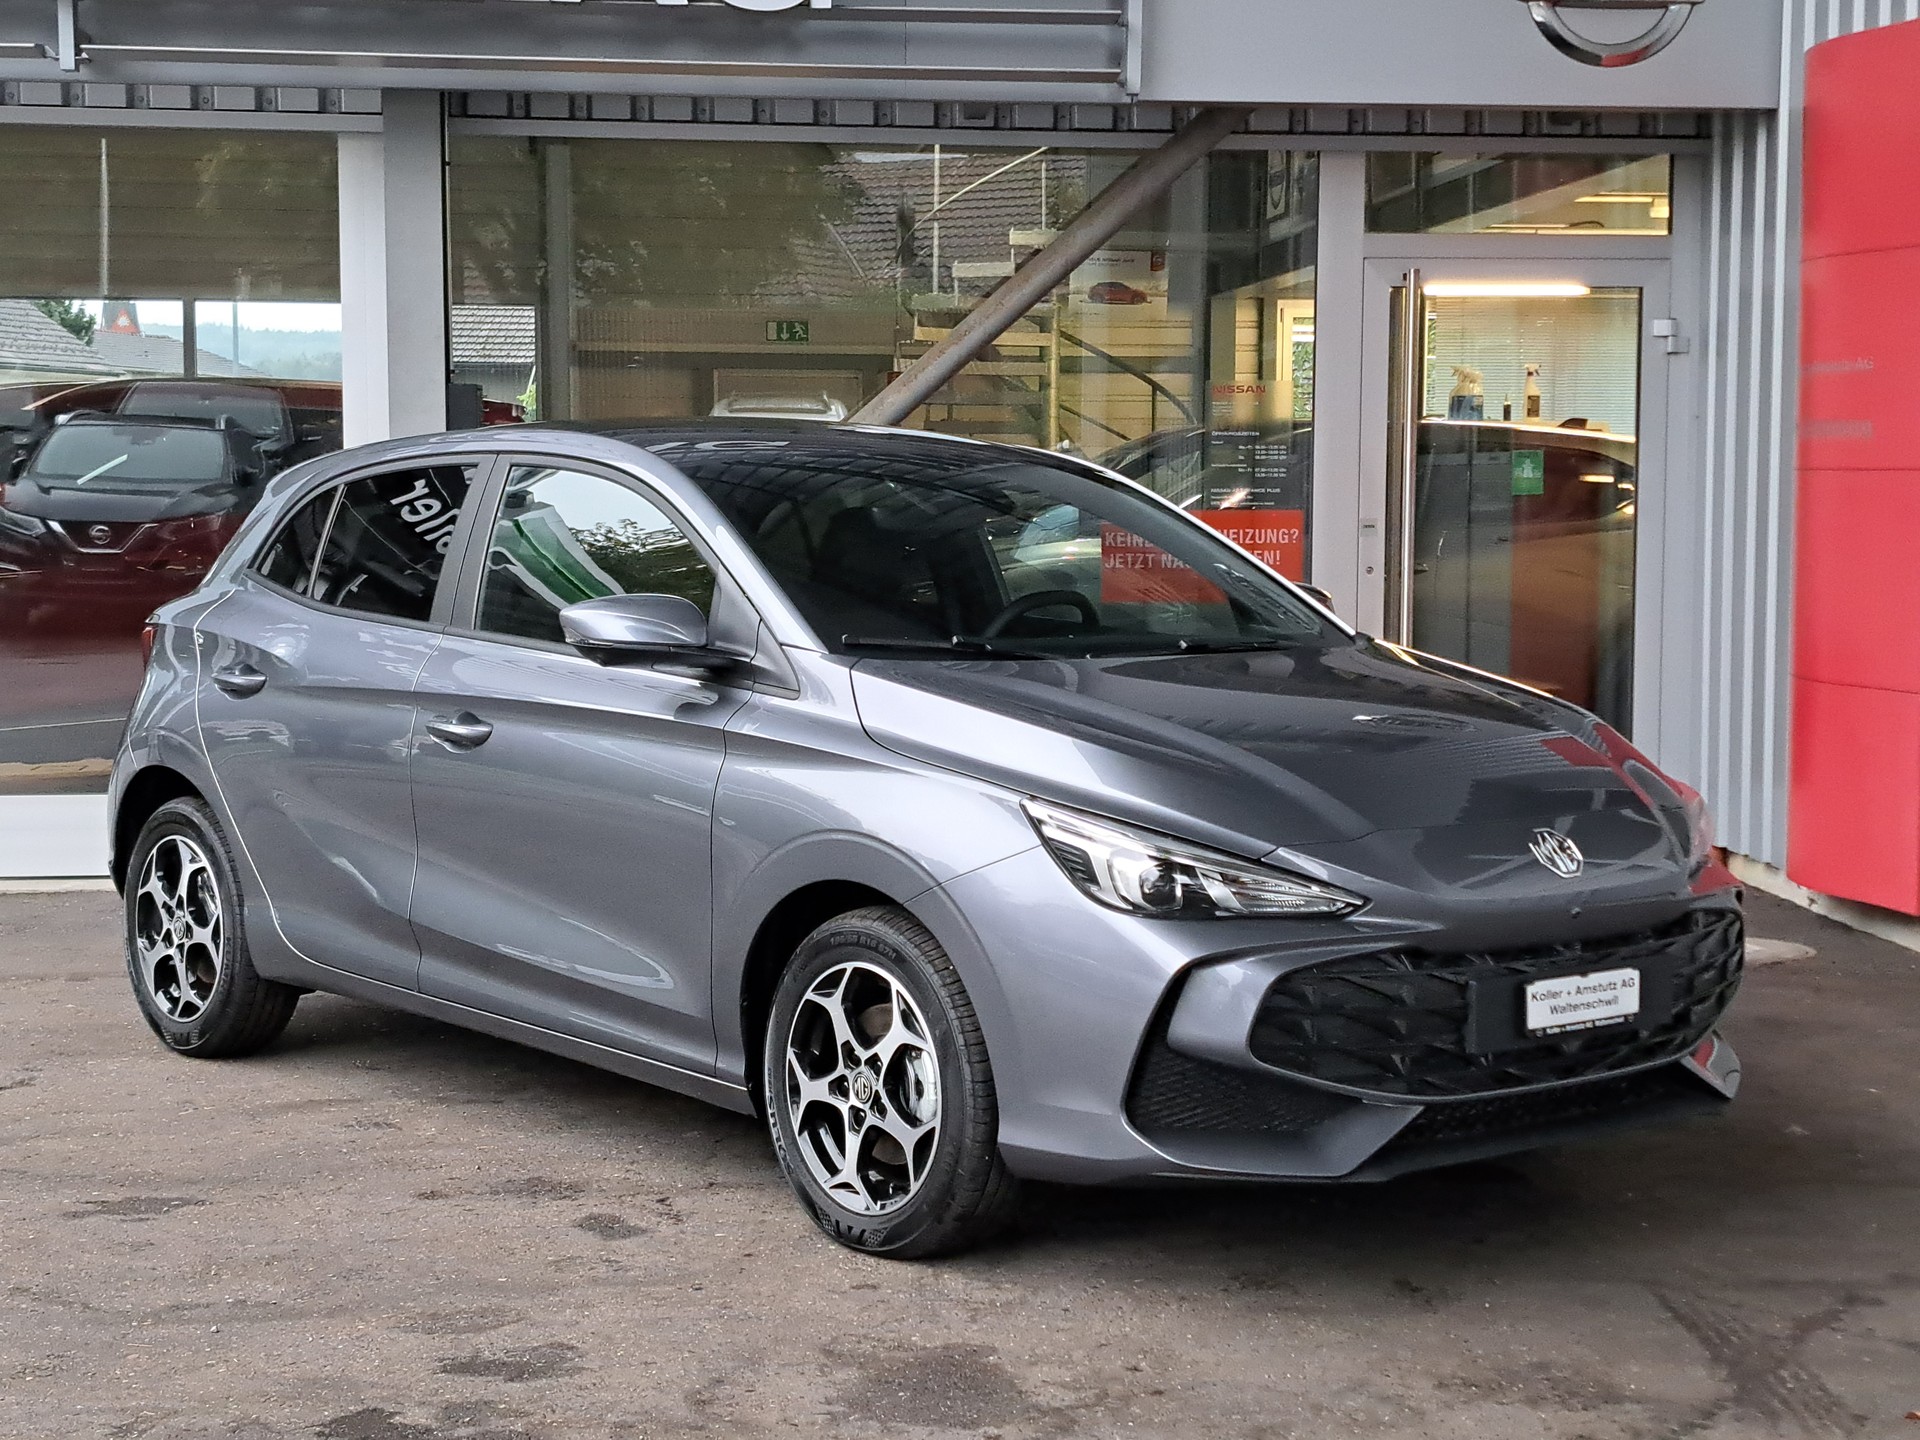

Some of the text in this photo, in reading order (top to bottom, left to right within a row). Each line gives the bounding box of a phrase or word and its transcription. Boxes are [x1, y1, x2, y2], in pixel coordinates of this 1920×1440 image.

[1212, 384, 1266, 394] NISSAN
[1104, 553, 1156, 569] JETZT
[1531, 990, 1563, 1002] Koller
[1575, 982, 1617, 996] Amstutz
[1621, 977, 1636, 988] AG
